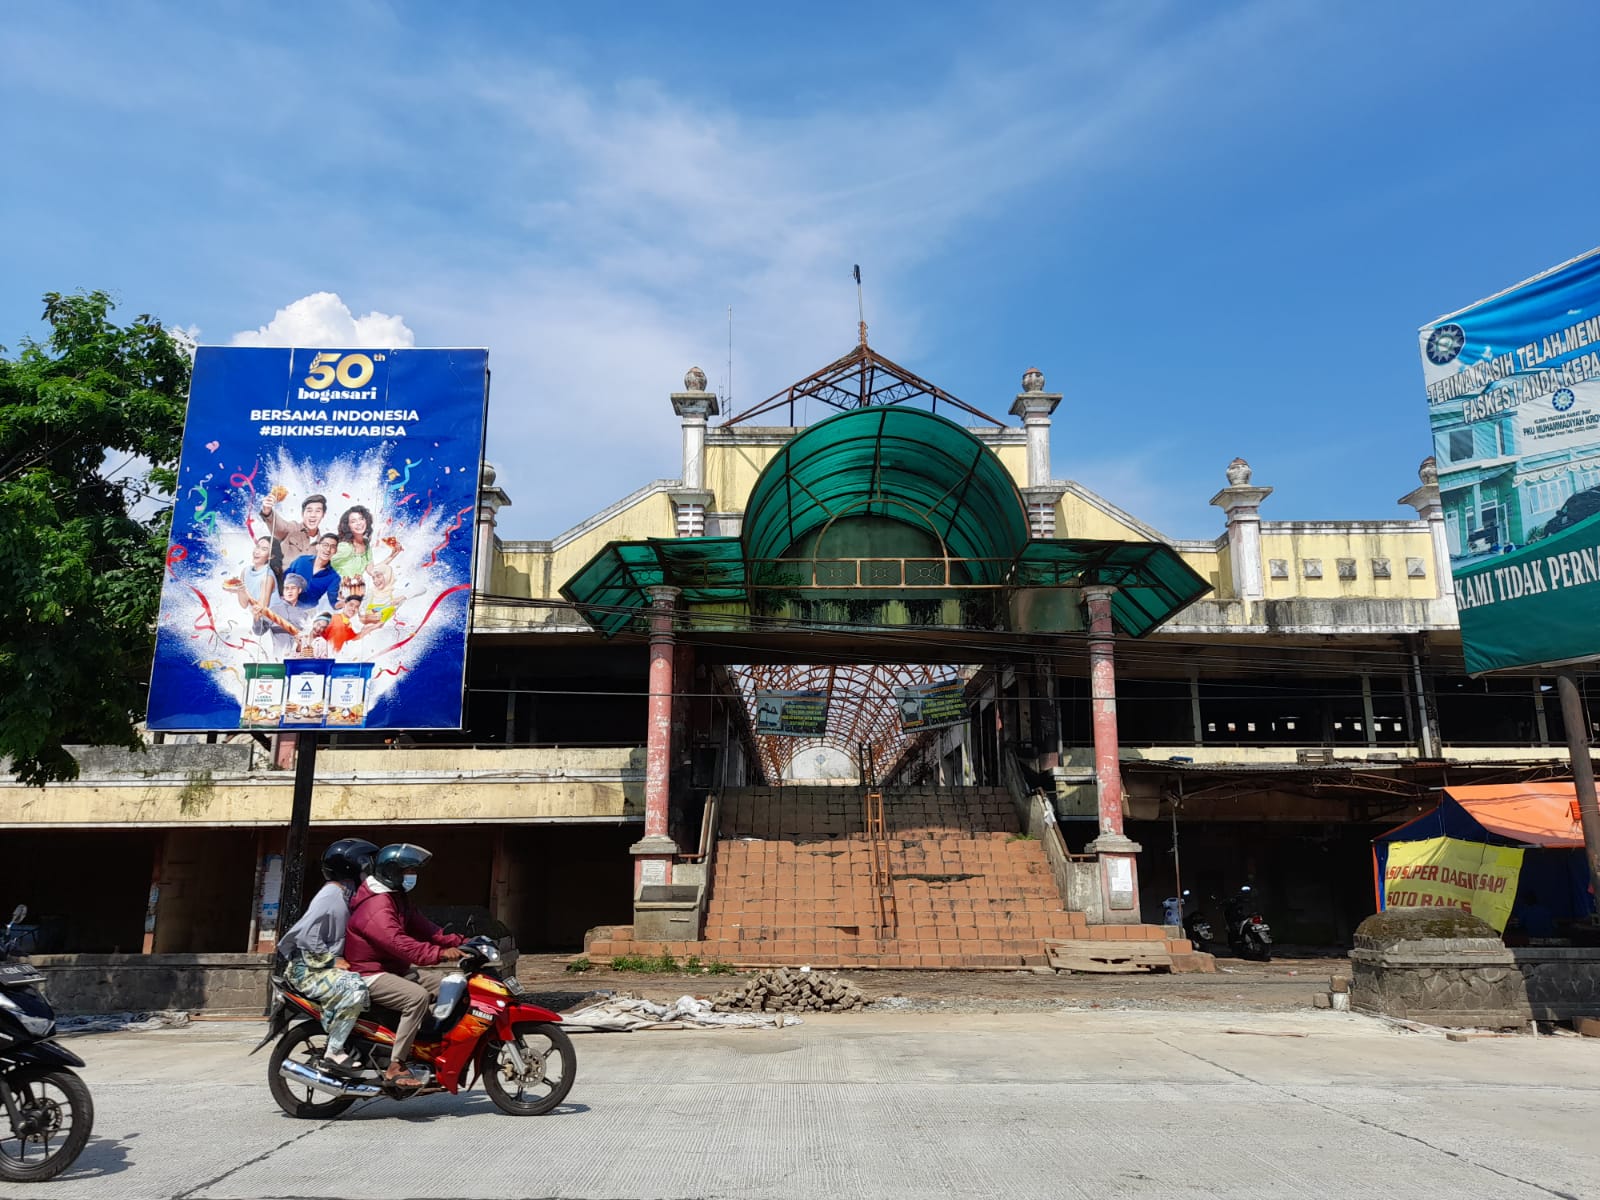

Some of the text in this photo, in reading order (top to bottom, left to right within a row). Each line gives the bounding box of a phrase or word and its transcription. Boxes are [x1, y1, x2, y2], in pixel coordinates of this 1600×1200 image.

[1427, 315, 1600, 407] TERIMA KASIH TELAH MEM
[297, 387, 377, 403] bogasari
[1462, 382, 1513, 424] FASKES
[1521, 368, 1561, 403] ANDA
[250, 409, 419, 421] BERSAMA INDONESIA
[259, 425, 407, 437] #BIKINSEMUABISA
[1536, 416, 1585, 434] MUHAMMADIYAH
[1453, 571, 1495, 611] KAMI
[1494, 559, 1548, 602] TIDAK
[1387, 891, 1418, 907] SOTO
[472, 1009, 493, 1021] YAMAHA
